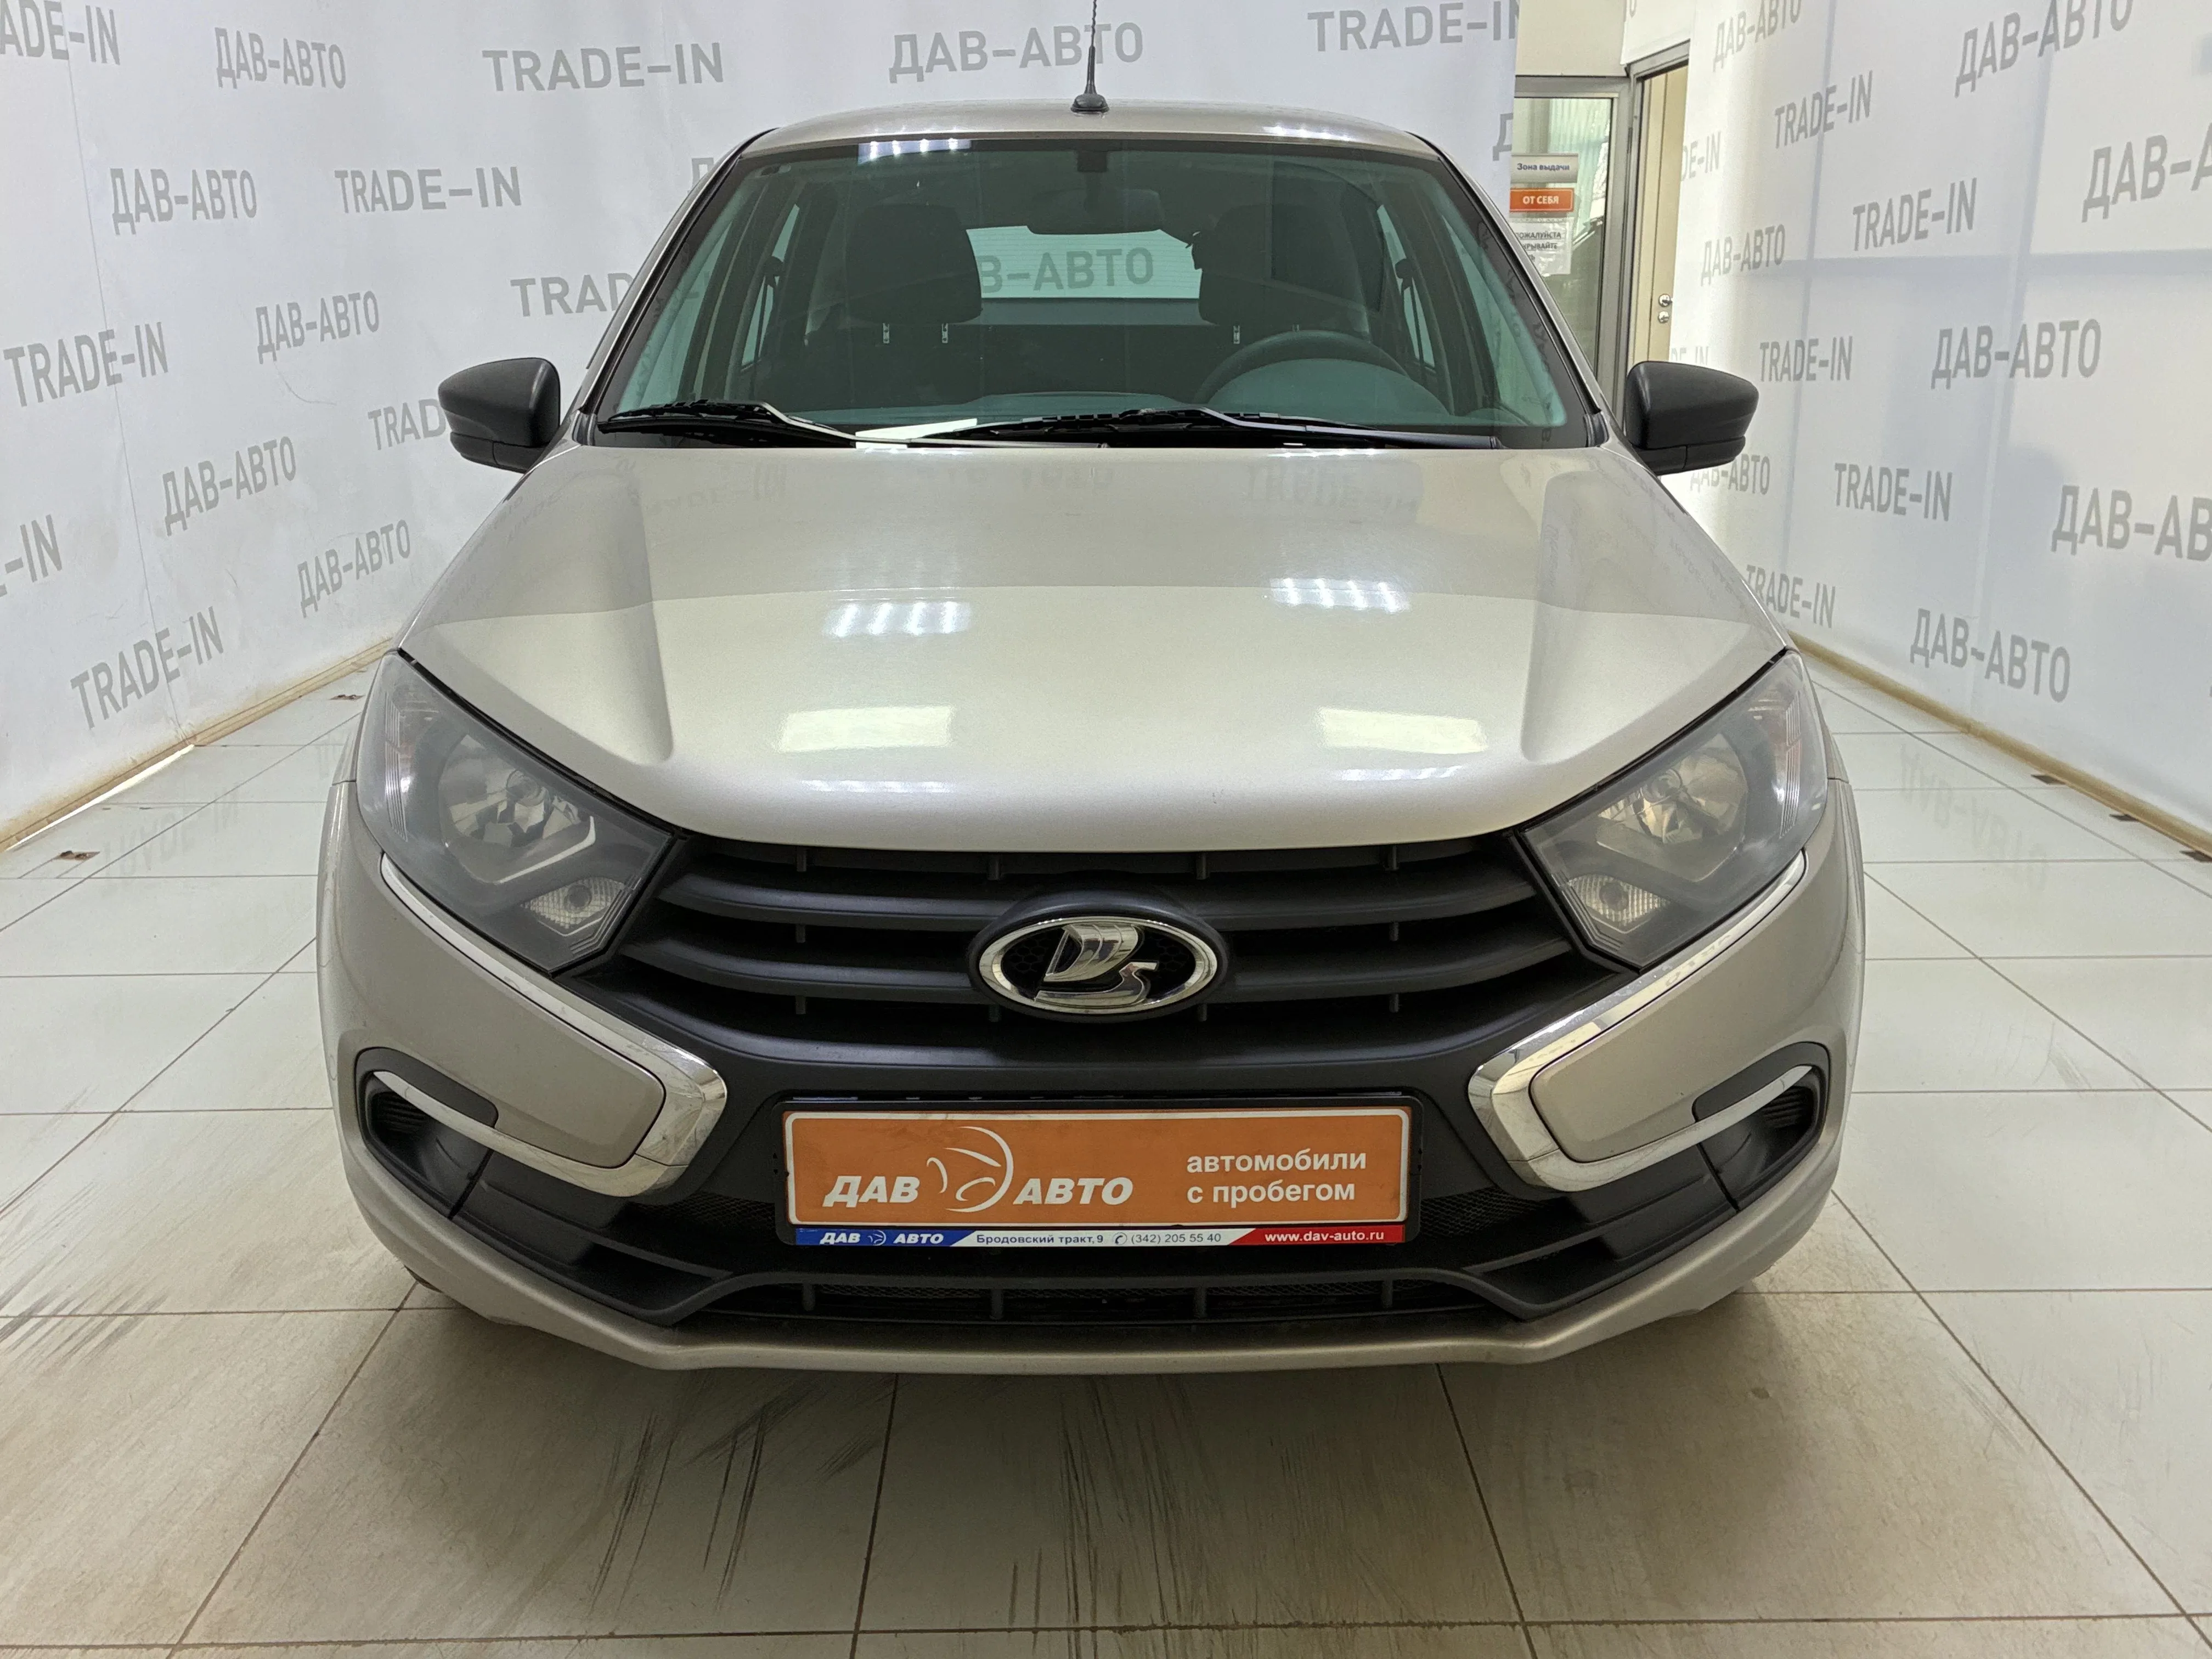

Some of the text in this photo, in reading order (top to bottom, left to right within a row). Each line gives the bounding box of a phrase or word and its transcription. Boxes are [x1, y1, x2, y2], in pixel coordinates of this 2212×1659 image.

[215, 27, 347, 89] ДАВ-АВТО
[482, 42, 723, 91] TRADE-IN
[889, 22, 1143, 83] ДАВ-АВТО
[1774, 70, 1873, 149] TRADE-IN
[110, 168, 257, 235] ДАВ-АВТО
[335, 166, 522, 213] TRADE-IN
[1522, 196, 1559, 204] ОТ СЕБЯ
[1852, 177, 1977, 251] TRADE-IN
[1701, 224, 1786, 286] ДАВ-АВТО
[256, 291, 379, 364] ДАВ-АВТО
[1931, 319, 2102, 390] ДАВ-АВТО
[3, 321, 168, 407] TRADE-IN
[1759, 336, 1853, 383] TRADE-IN
[162, 437, 296, 536] ДАВ-АВТО
[1835, 462, 1953, 522] TRADE-IN
[297, 520, 411, 618] ДАВ-АВТО
[1746, 565, 1836, 628] TRADE-IN
[70, 606, 224, 729] TRADE-IN
[1910, 608, 2070, 703] ДАВ-АВТО
[822, 1175, 1133, 1207] ДАВ АВТО
[1187, 1148, 1367, 1173] автомобили
[1187, 1179, 1356, 1208] с пробегом
[819, 1233, 944, 1245] ДАВ АВТО
[977, 1233, 1054, 1245] Бродовский
[1131, 1234, 1161, 1244] (342)
[1165, 1234, 1186, 1243] 205
[1189, 1234, 1204, 1243] 55
[1207, 1233, 1221, 1242] 40
[1264, 1231, 1385, 1243] www.dav-auto.ru
